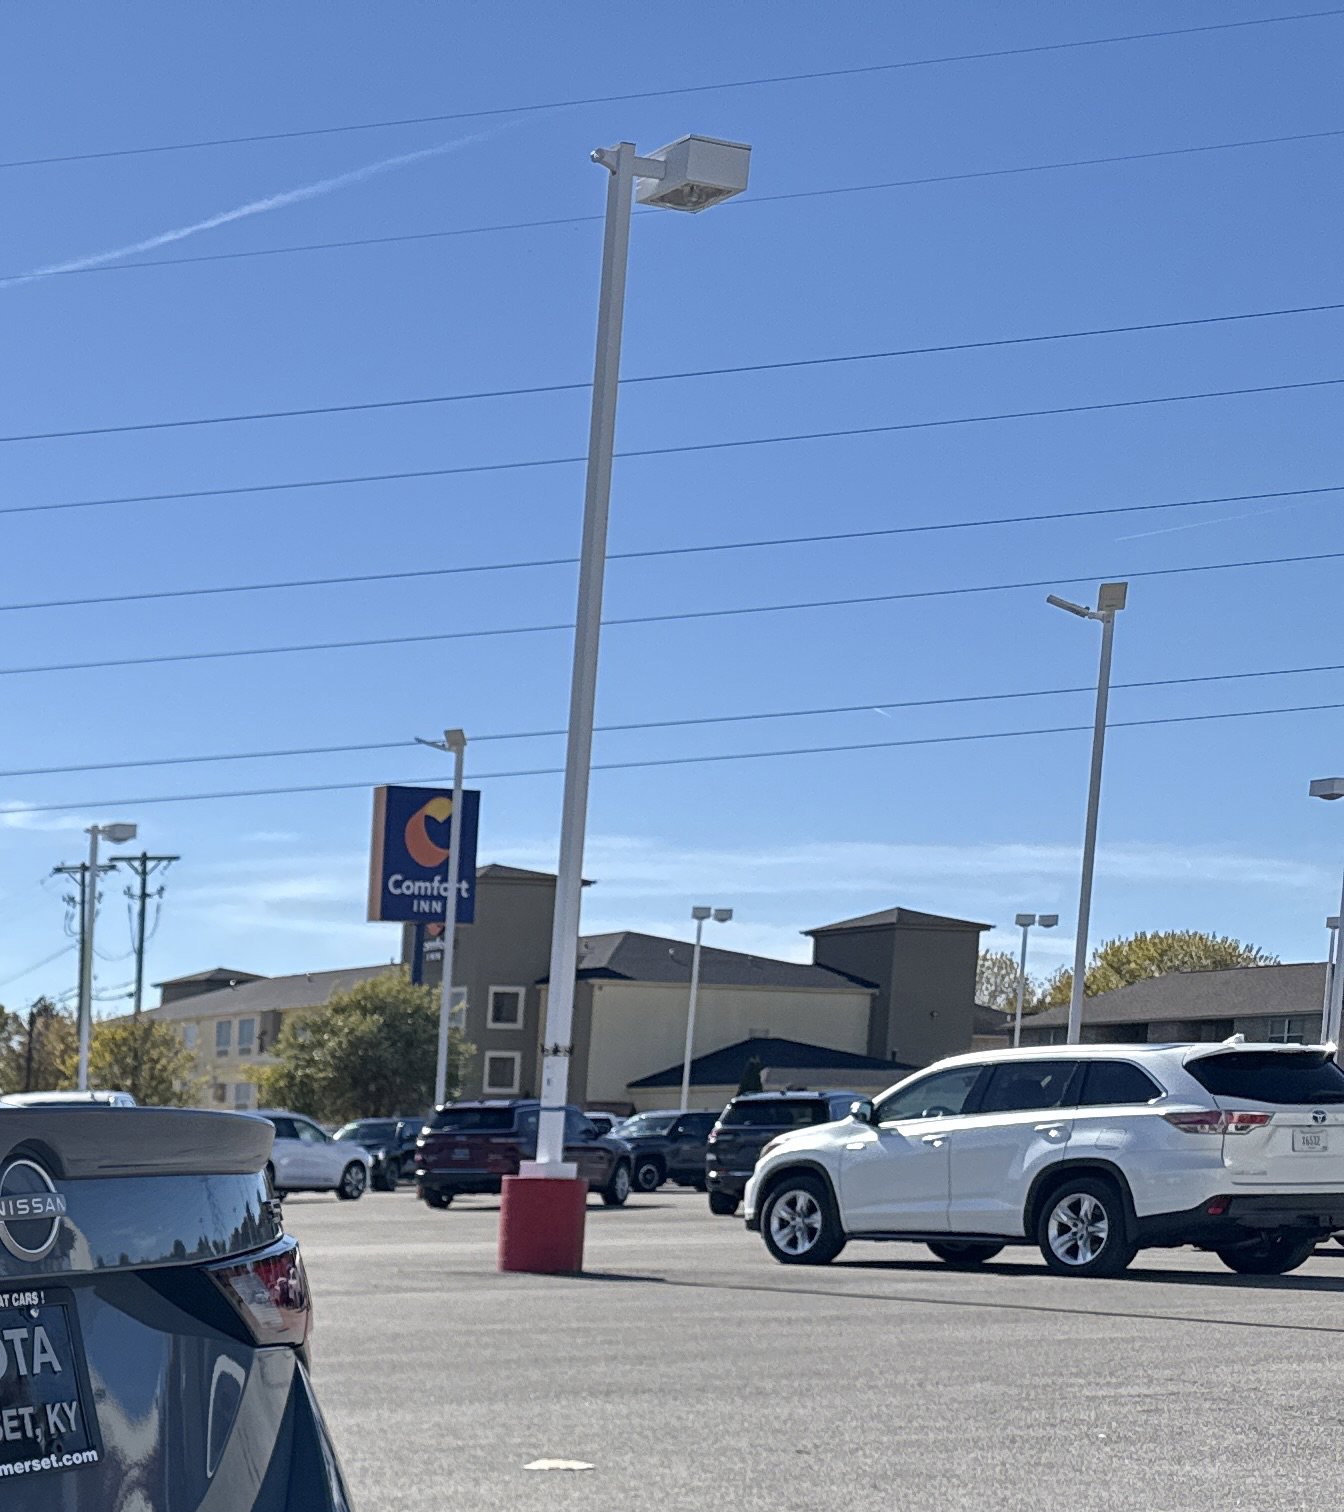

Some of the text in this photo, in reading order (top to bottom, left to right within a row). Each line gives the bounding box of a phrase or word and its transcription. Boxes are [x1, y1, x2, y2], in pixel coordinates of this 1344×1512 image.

[388, 873, 469, 898] Comfot
[413, 899, 443, 913] INN
[46, 1401, 77, 1435] KY
